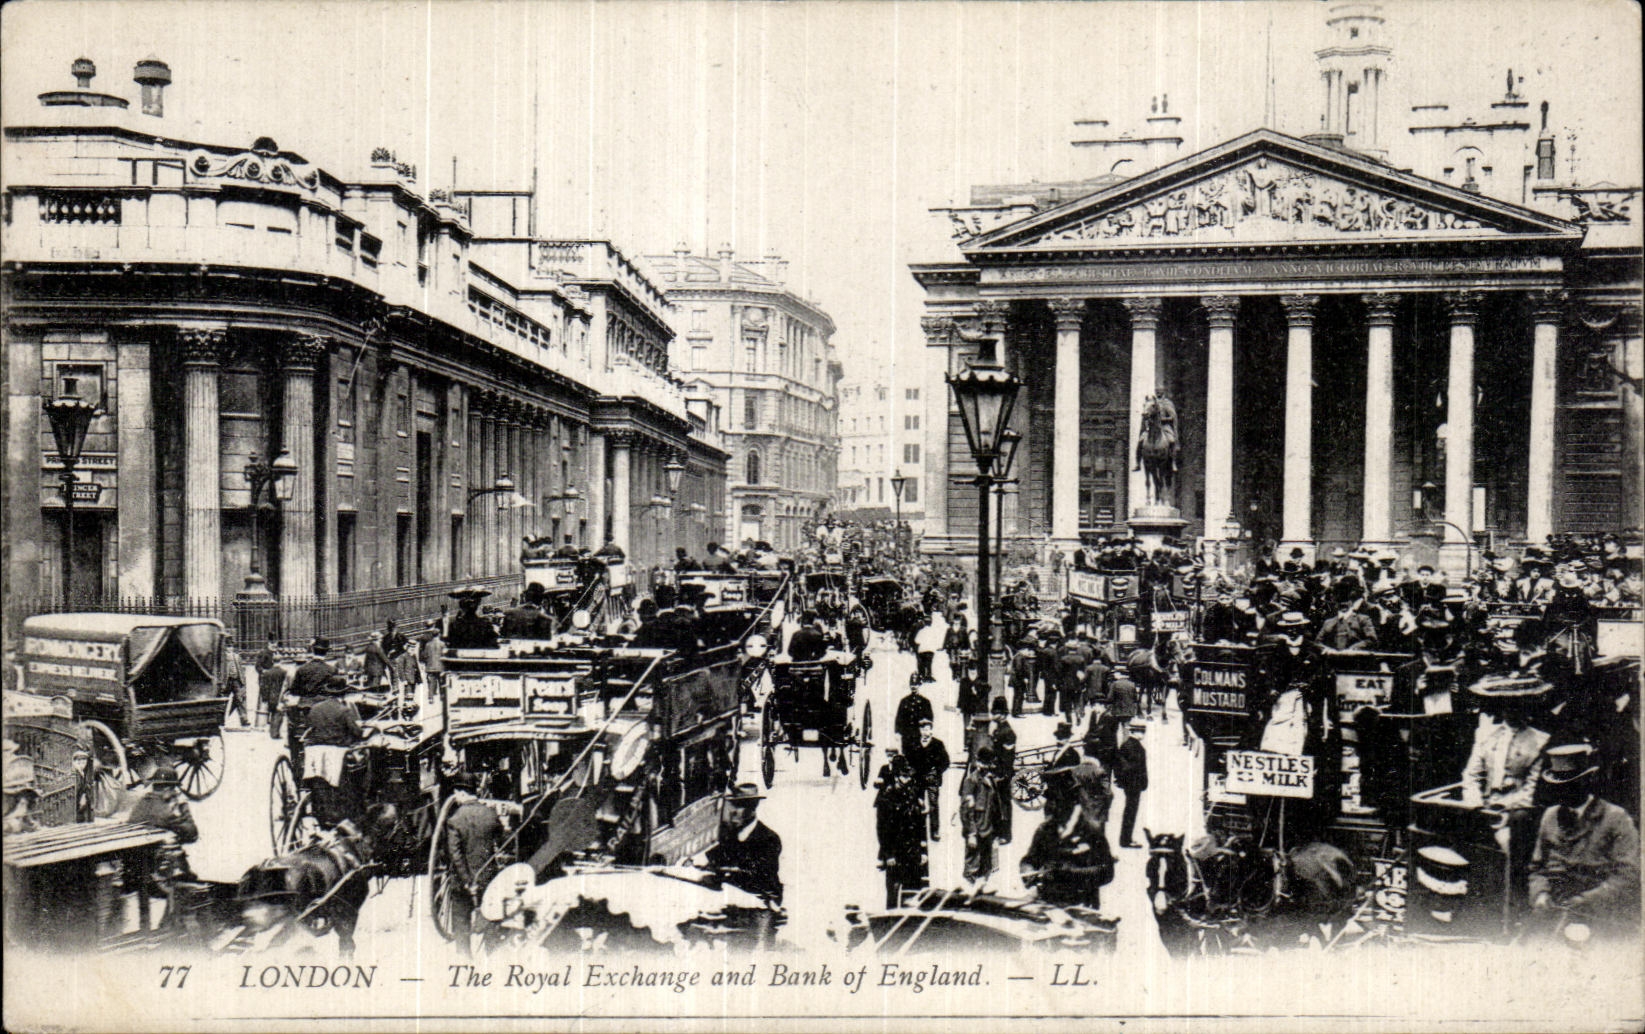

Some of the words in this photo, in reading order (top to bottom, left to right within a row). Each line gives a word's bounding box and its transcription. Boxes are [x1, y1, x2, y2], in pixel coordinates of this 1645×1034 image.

[81, 457, 115, 465] STREET
[1355, 678, 1386, 690] EAT
[1193, 688, 1246, 709] MUSTARD
[1262, 772, 1308, 788] MILK
